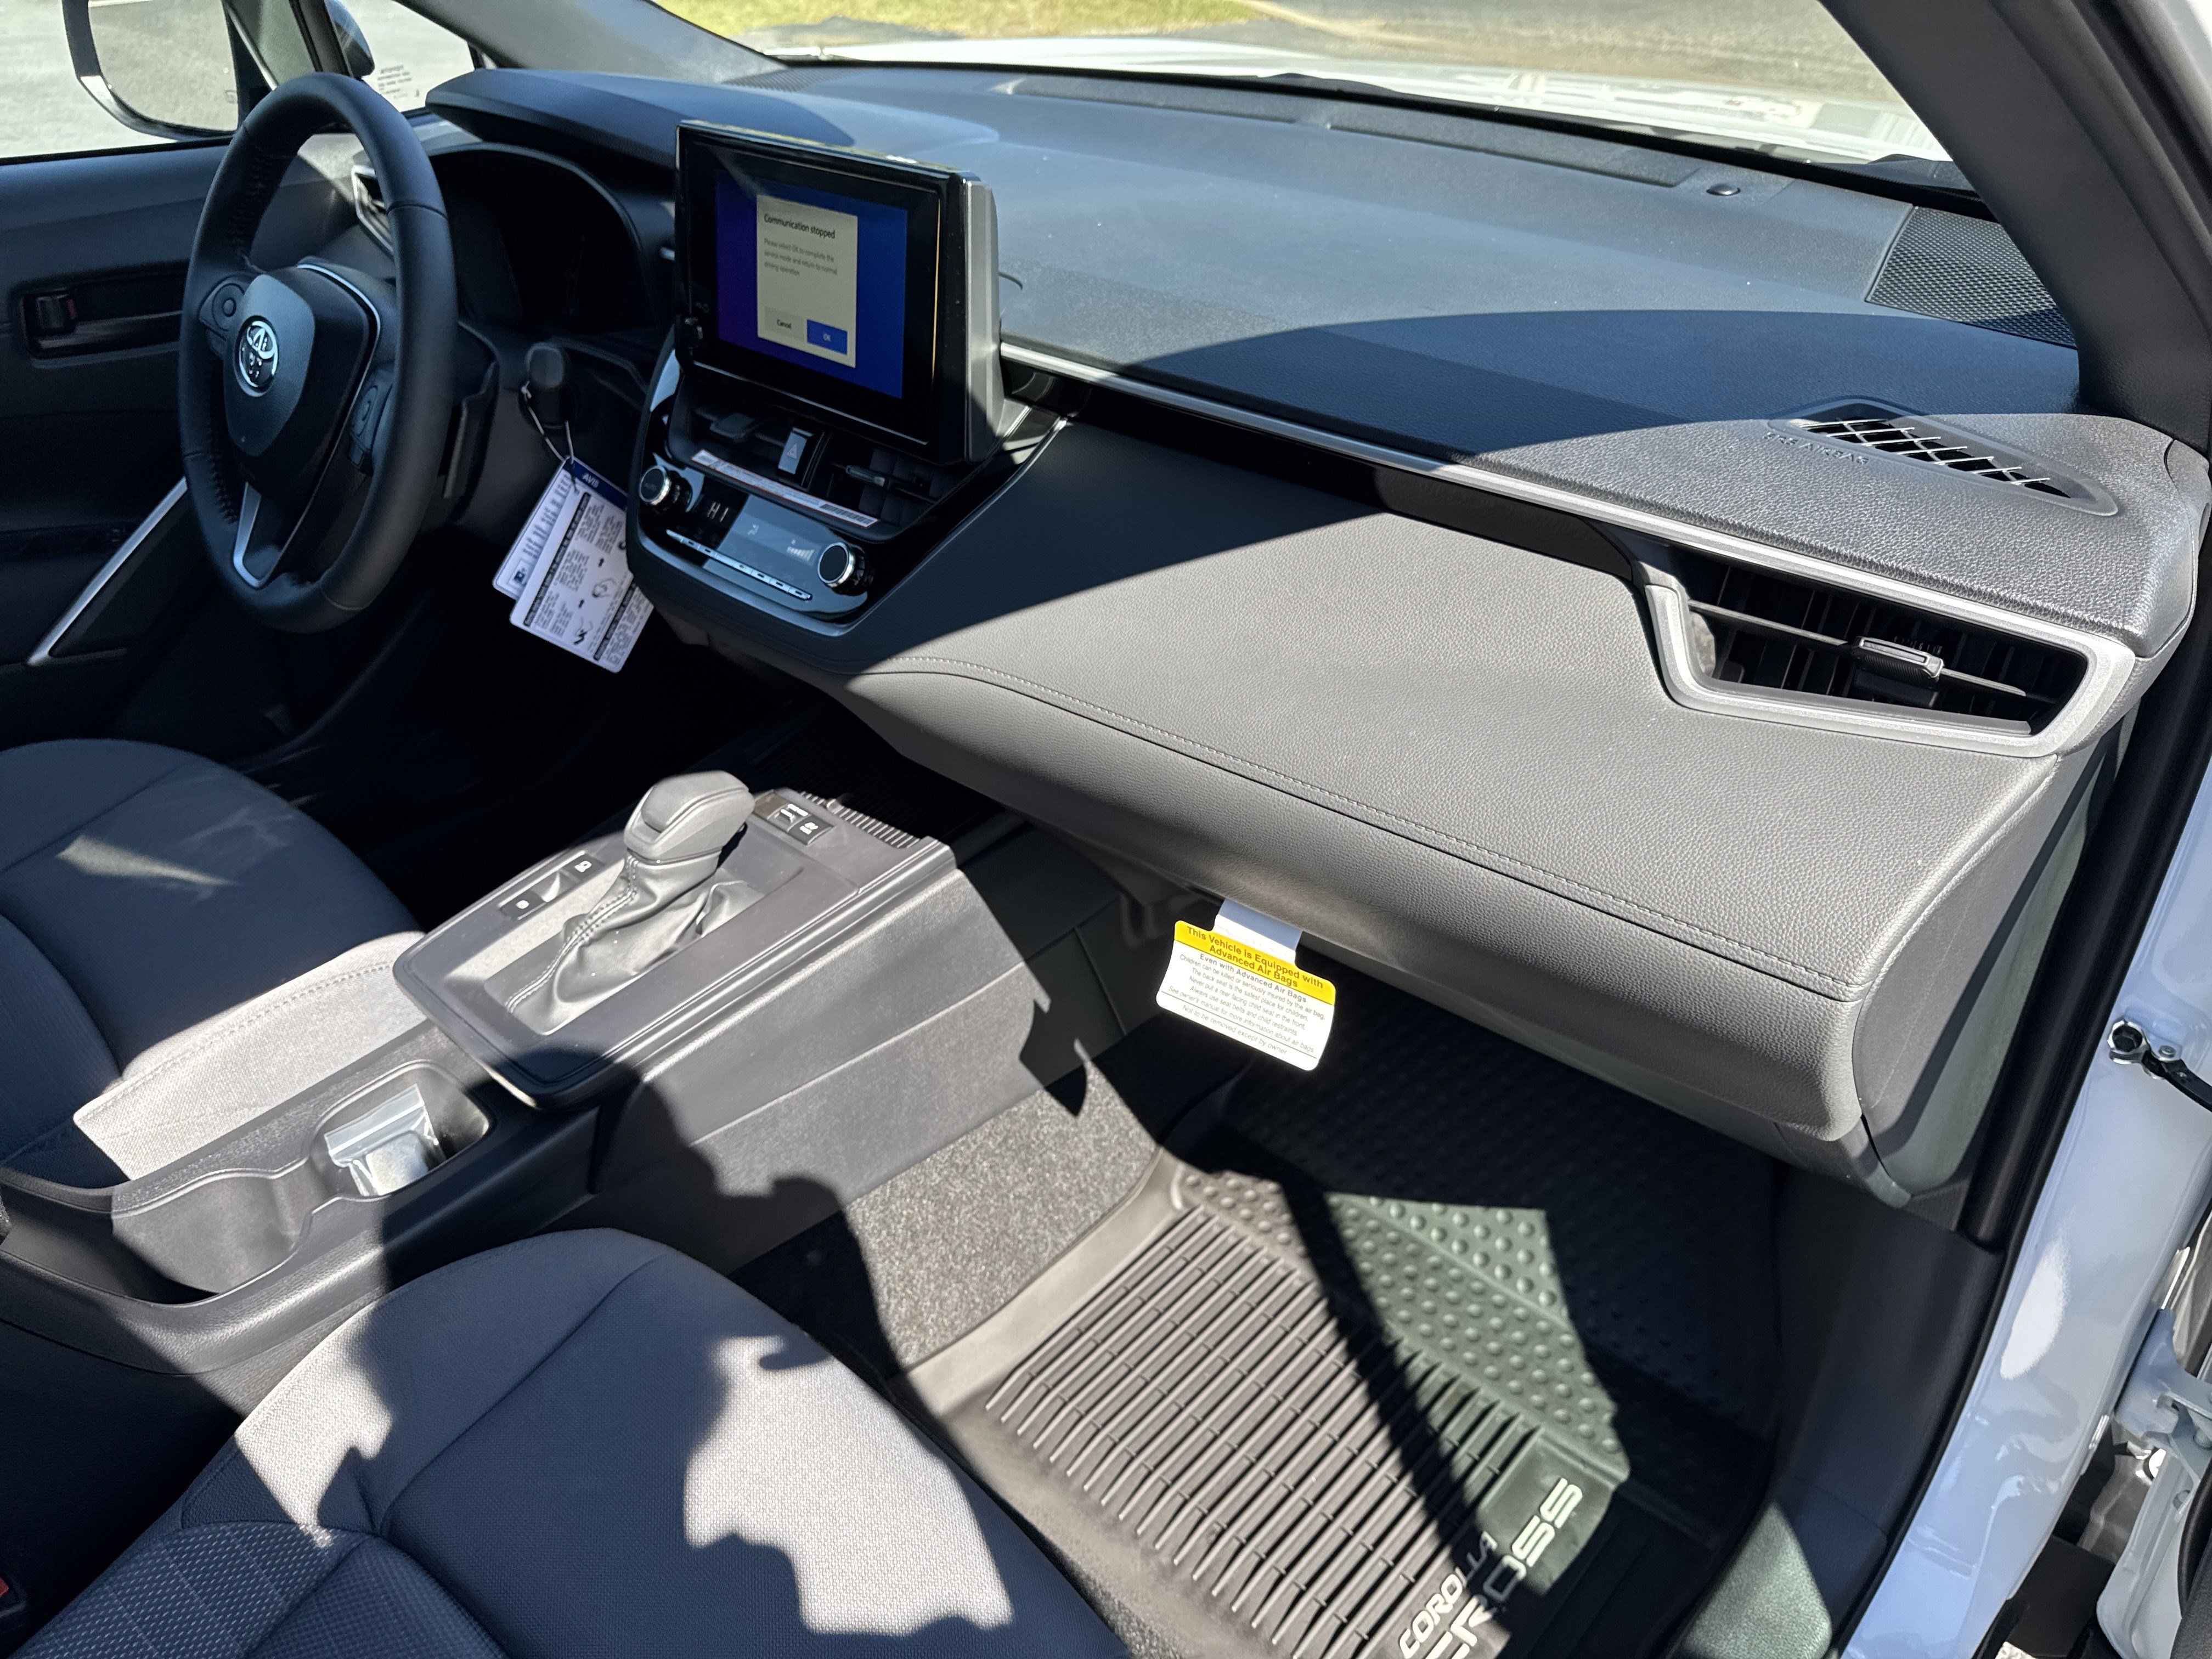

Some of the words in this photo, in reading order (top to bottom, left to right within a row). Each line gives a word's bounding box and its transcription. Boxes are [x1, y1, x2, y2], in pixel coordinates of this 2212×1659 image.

[763, 213, 809, 232] Communication
[810, 227, 836, 239] stopped
[776, 319, 792, 330] Cancel
[823, 333, 831, 342] OK
[1798, 443, 1870, 465] AIRBAG
[1187, 926, 1206, 940] This
[1209, 934, 1242, 955] Vehicle
[1244, 949, 1252, 959] is
[1255, 953, 1300, 979] Equipped
[1302, 974, 1323, 989] with
[1200, 953, 1217, 966] Even
[1220, 962, 1234, 973] with
[1236, 969, 1273, 988] Advanced
[1274, 985, 1285, 994] Air
[1287, 990, 1307, 1003] Bags
[1209, 945, 1255, 970] Advanced
[1257, 964, 1271, 976] Air
[1274, 971, 1298, 988] Bags
[1180, 953, 1201, 967] Children
[1221, 970, 1235, 981] killed
[1242, 981, 1266, 996] seriously
[1267, 991, 1286, 1003] injured
[1287, 998, 1293, 1007] by
[1313, 1009, 1325, 1020] bag.
[1189, 975, 1204, 986] Never
[1232, 993, 1247, 1006] facing
[1249, 1002, 1262, 1011] child
[1262, 1008, 1274, 1017] seat
[1282, 1015, 1290, 1023] the
[1190, 986, 1208, 998] Always
[1220, 999, 1232, 1008] seat
[1232, 1004, 1245, 1014] belts
[1246, 1011, 1257, 1019] and
[1258, 1015, 1272, 1024] child
[1192, 967, 1201, 976] The
[1203, 972, 1215, 981] back
[1216, 979, 1228, 987] seat
[1244, 990, 1260, 1001] safest
[1261, 998, 1276, 1007] place
[1285, 1008, 1308, 1021] children.
[1169, 985, 1179, 994] See
[1180, 991, 1199, 1003] owner's
[1200, 1001, 1220, 1012] manual
[1229, 1013, 1243, 1022] more
[1244, 1019, 1273, 1034] information
[1274, 1032, 1291, 1042] about
[1182, 1005, 1193, 1014] Not
[1211, 1018, 1237, 1031] removed
[1238, 1029, 1258, 1042] except
[1259, 1038, 1267, 1046] by
[1268, 1043, 1288, 1054] owner
[1400, 1531, 1498, 1659] COROLLA
